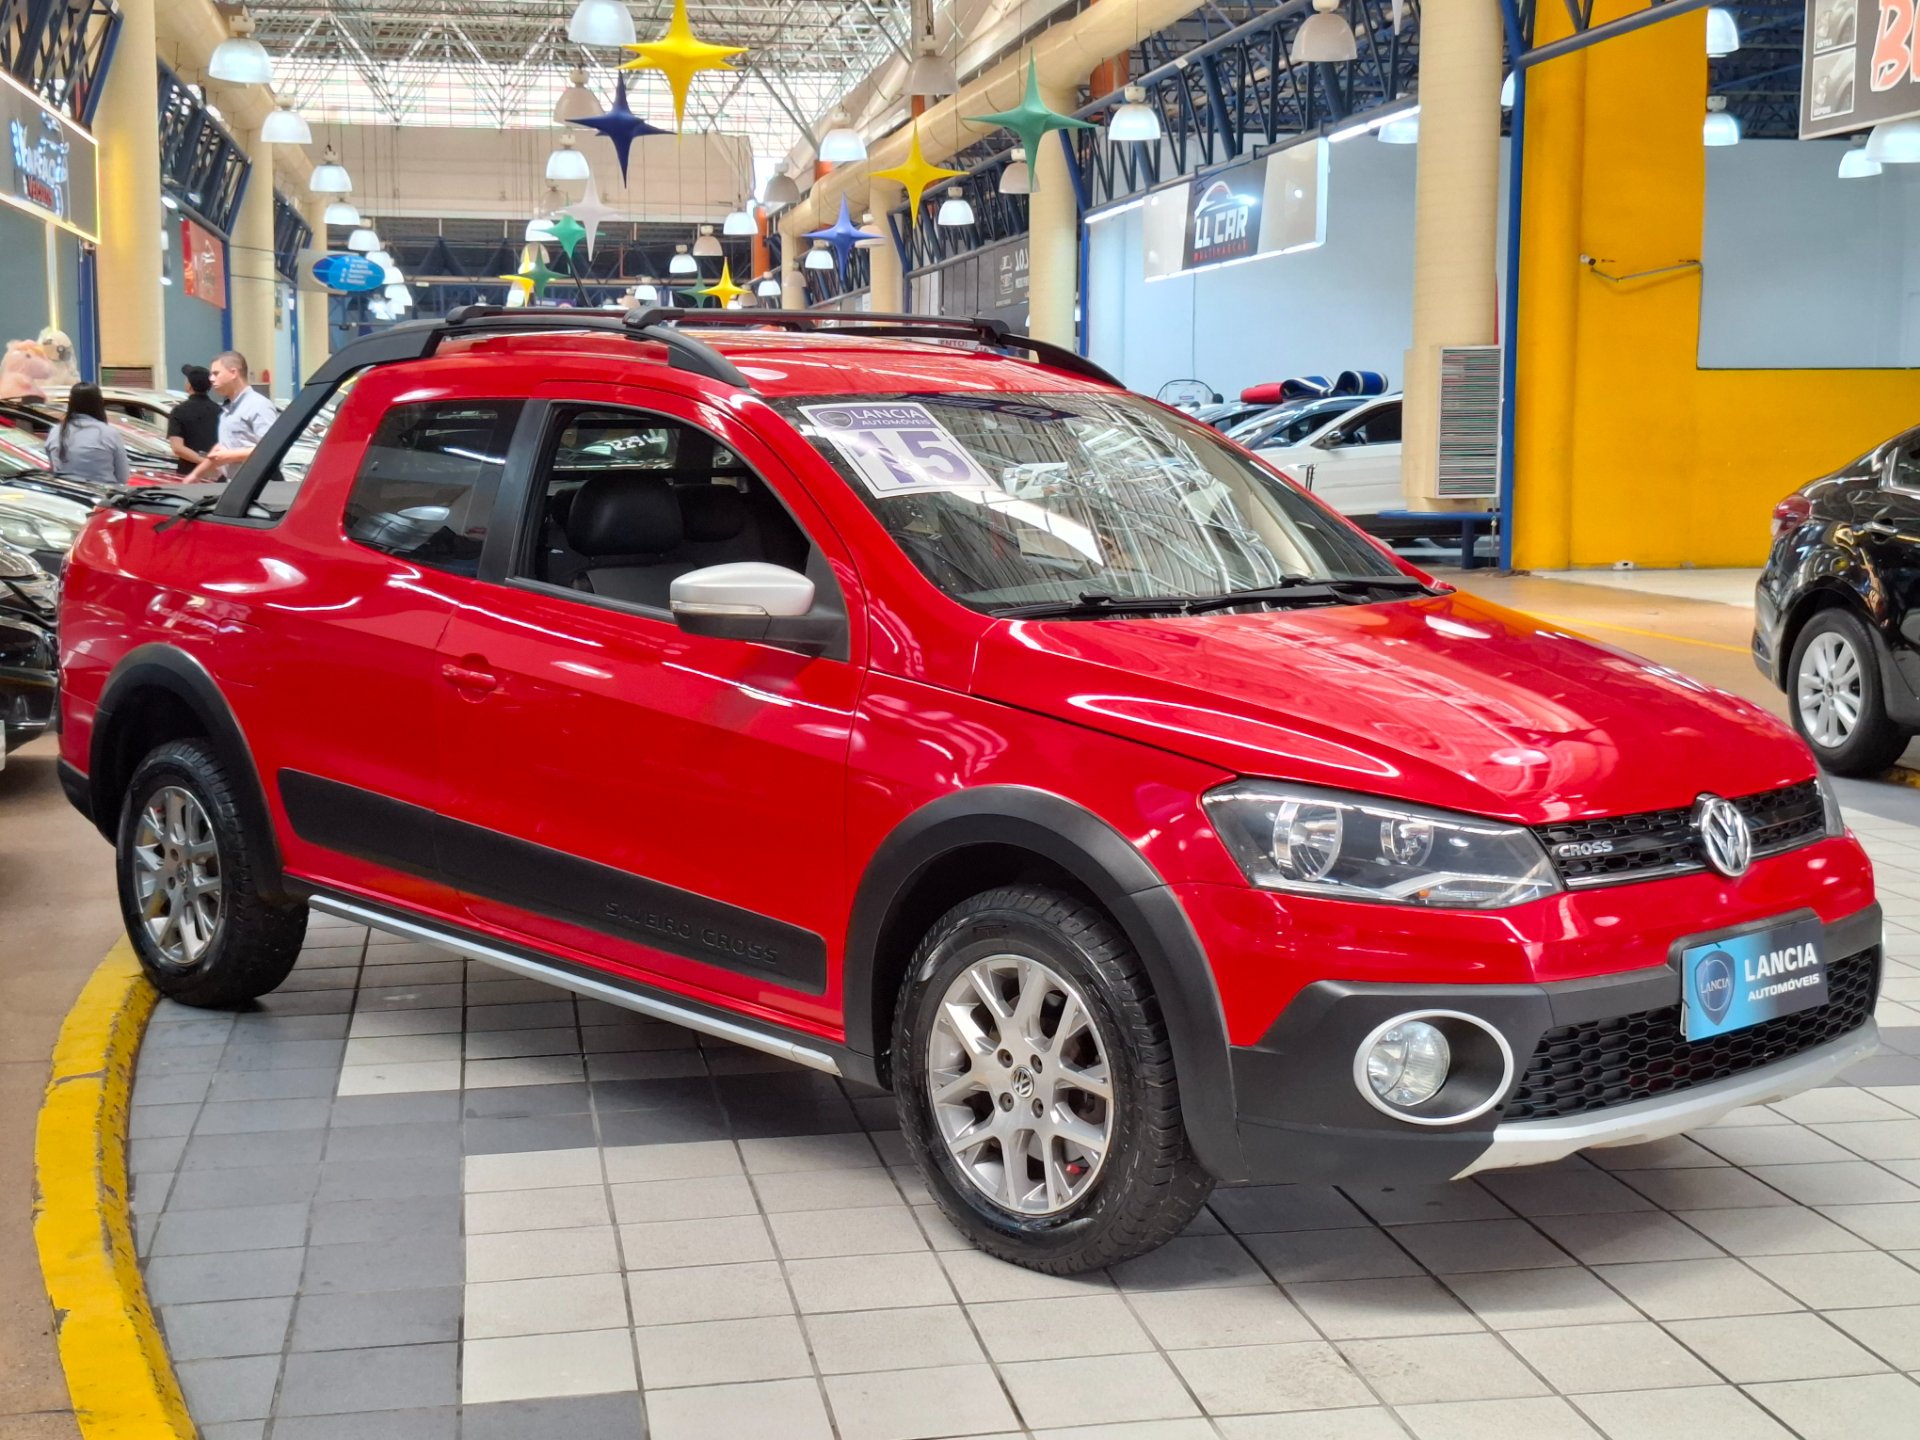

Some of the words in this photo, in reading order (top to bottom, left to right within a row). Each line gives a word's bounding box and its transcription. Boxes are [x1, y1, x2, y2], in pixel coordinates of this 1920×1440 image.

[1870, 0, 1920, 92] B
[1194, 216, 1211, 249] LL
[1213, 205, 1249, 245] CAR
[851, 408, 925, 420] LANCIA
[861, 417, 932, 427] AUTOMÓVEIS
[852, 430, 971, 484] 15
[1558, 840, 1613, 858] CROSS
[605, 902, 690, 939] SEIRO
[702, 928, 778, 965] CROSS
[1744, 942, 1818, 982] LANCIA
[1700, 977, 1729, 994] LANCIA
[1747, 973, 1820, 1002] AUTOMÓVEIS
